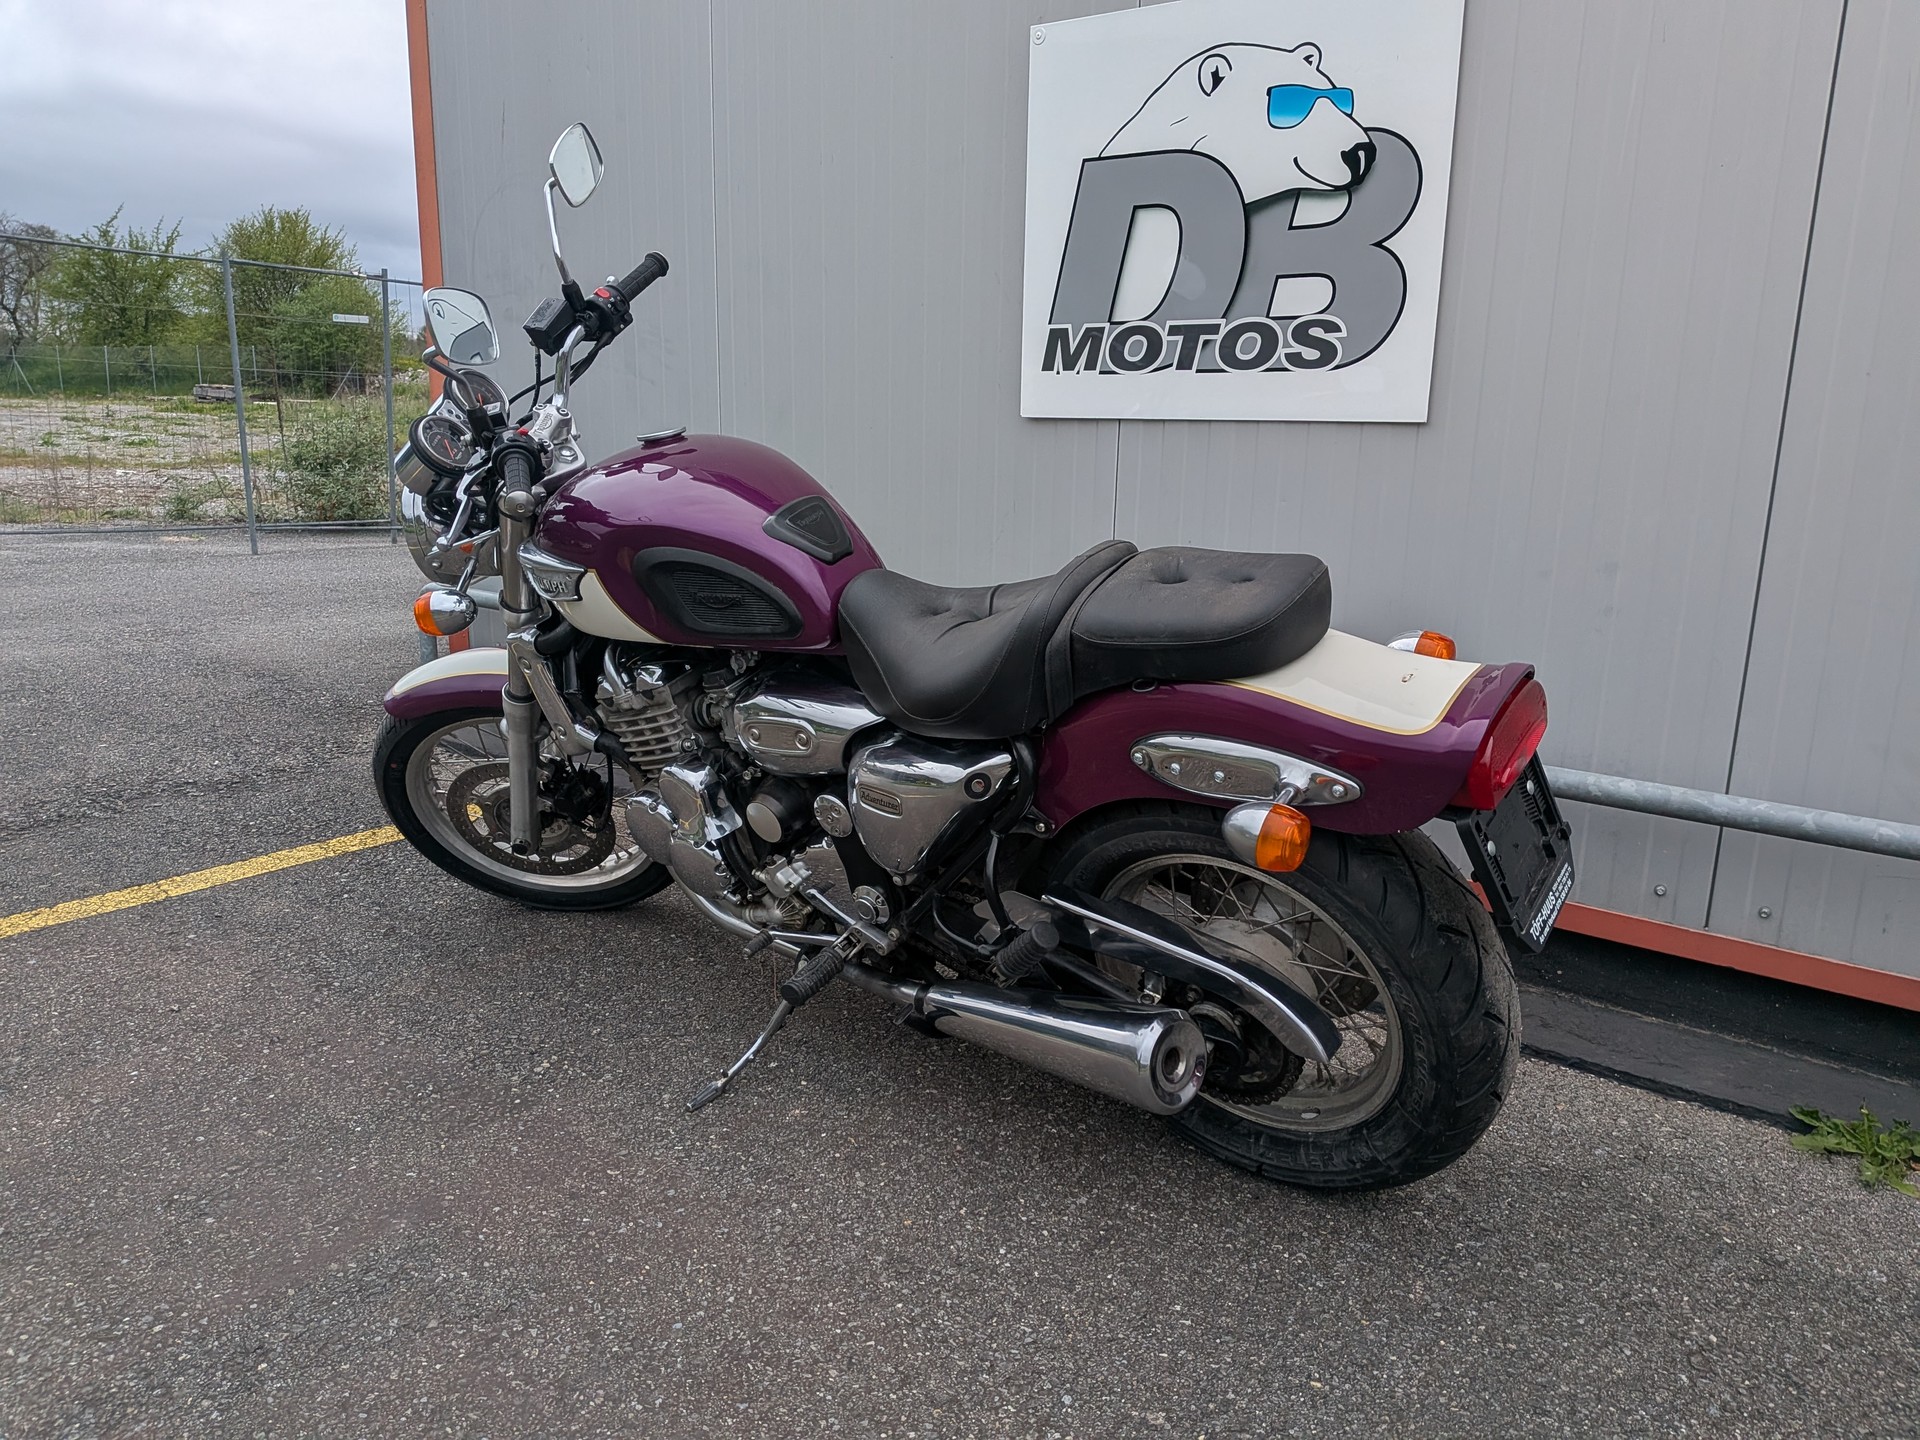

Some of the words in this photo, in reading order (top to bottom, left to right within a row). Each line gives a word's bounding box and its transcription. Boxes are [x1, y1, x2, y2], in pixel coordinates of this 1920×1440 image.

[1048, 127, 1423, 374] DB
[1041, 315, 1347, 374] MOTOS
[860, 791, 899, 810] Adventurer
[1530, 892, 1556, 940] TÖFF-HUUS
